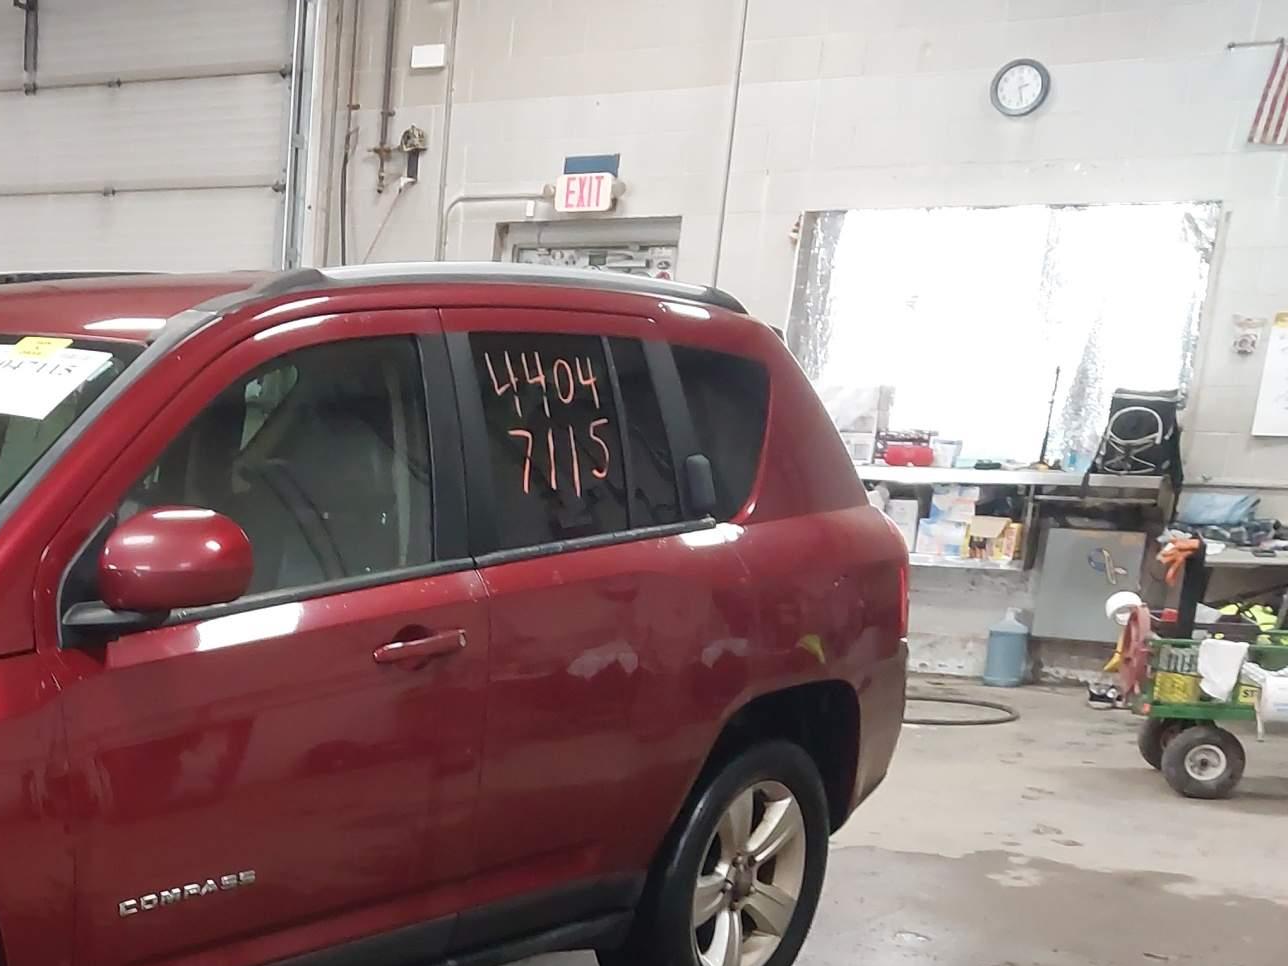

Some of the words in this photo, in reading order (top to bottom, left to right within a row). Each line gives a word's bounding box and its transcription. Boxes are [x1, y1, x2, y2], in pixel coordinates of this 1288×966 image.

[565, 176, 604, 208] EXIT
[484, 350, 601, 418] 4404
[508, 418, 609, 499] 7115
[118, 869, 256, 918] COMPASS
